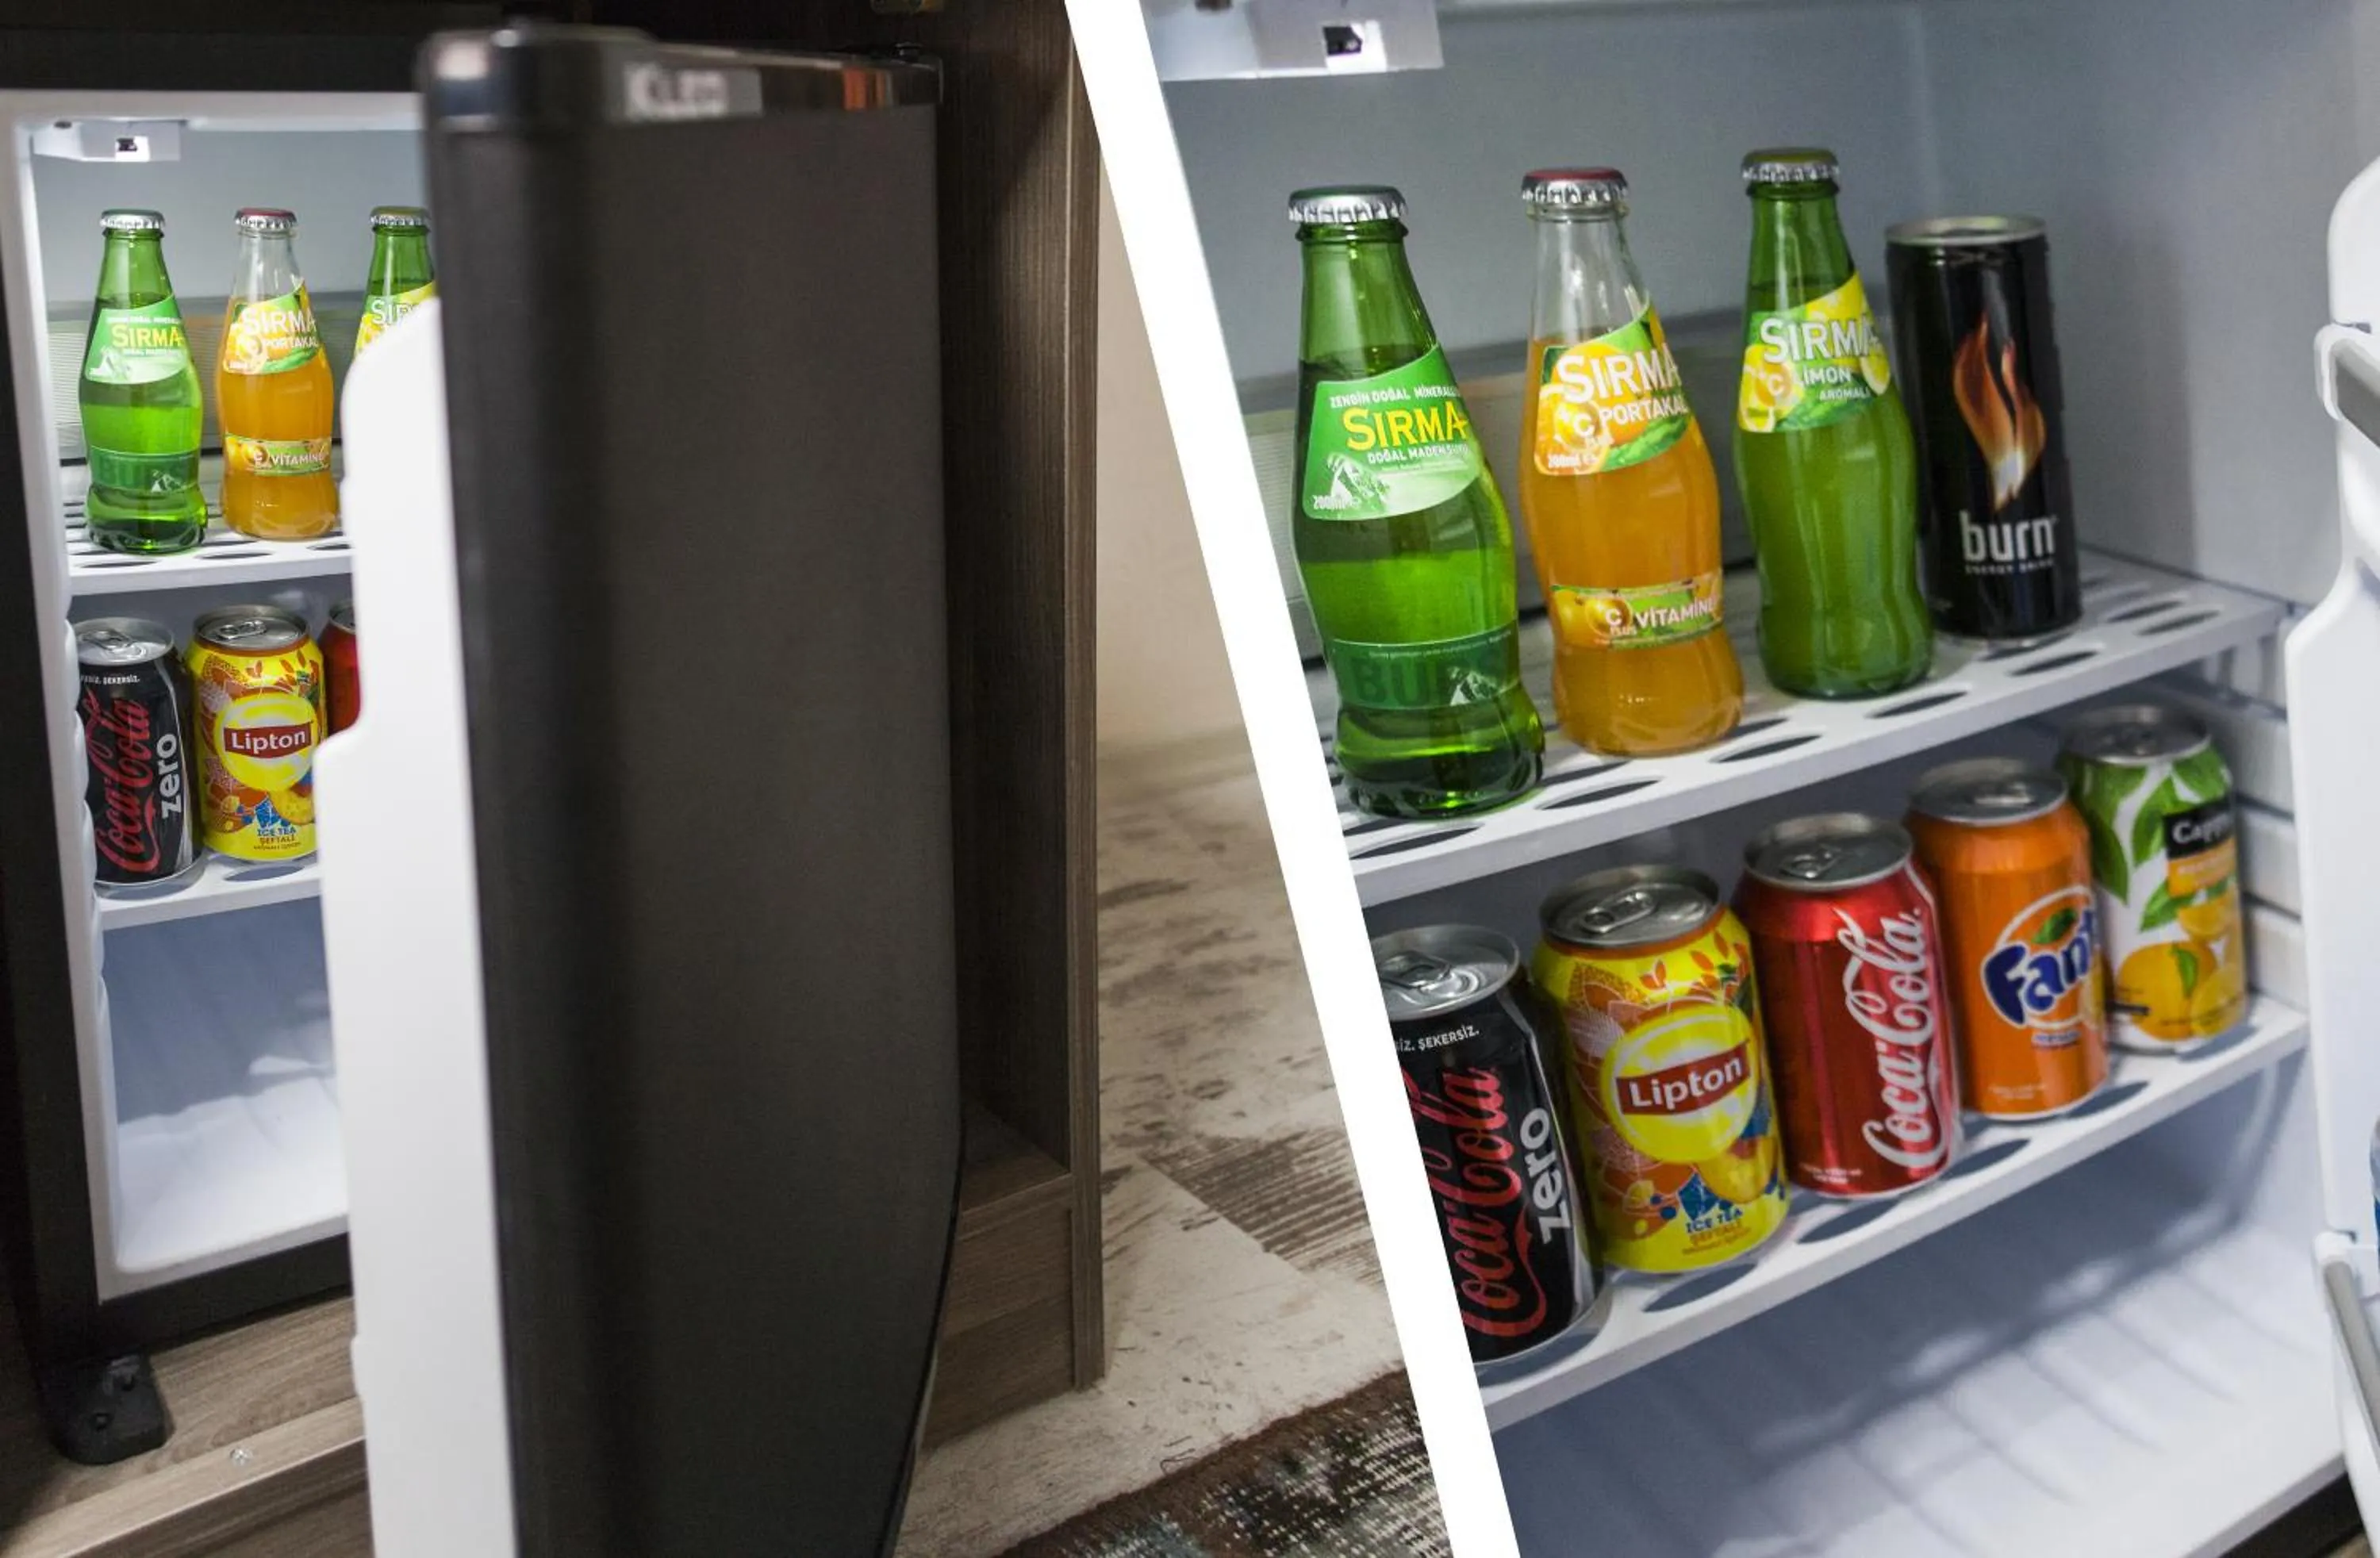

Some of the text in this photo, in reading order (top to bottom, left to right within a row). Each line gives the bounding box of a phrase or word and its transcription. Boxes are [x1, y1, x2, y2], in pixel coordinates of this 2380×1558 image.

[112, 324, 185, 347] SIRMA
[241, 309, 317, 334] SIRMA
[1760, 315, 1879, 364] SIRMA
[1557, 343, 1682, 403] SIRMA
[1343, 400, 1468, 451] SIRMA
[1959, 508, 2055, 562] burn
[231, 727, 306, 754] Lipton
[156, 734, 182, 819] zero
[1629, 1054, 1743, 1112] Lipton
[1520, 1107, 1570, 1245] zero
